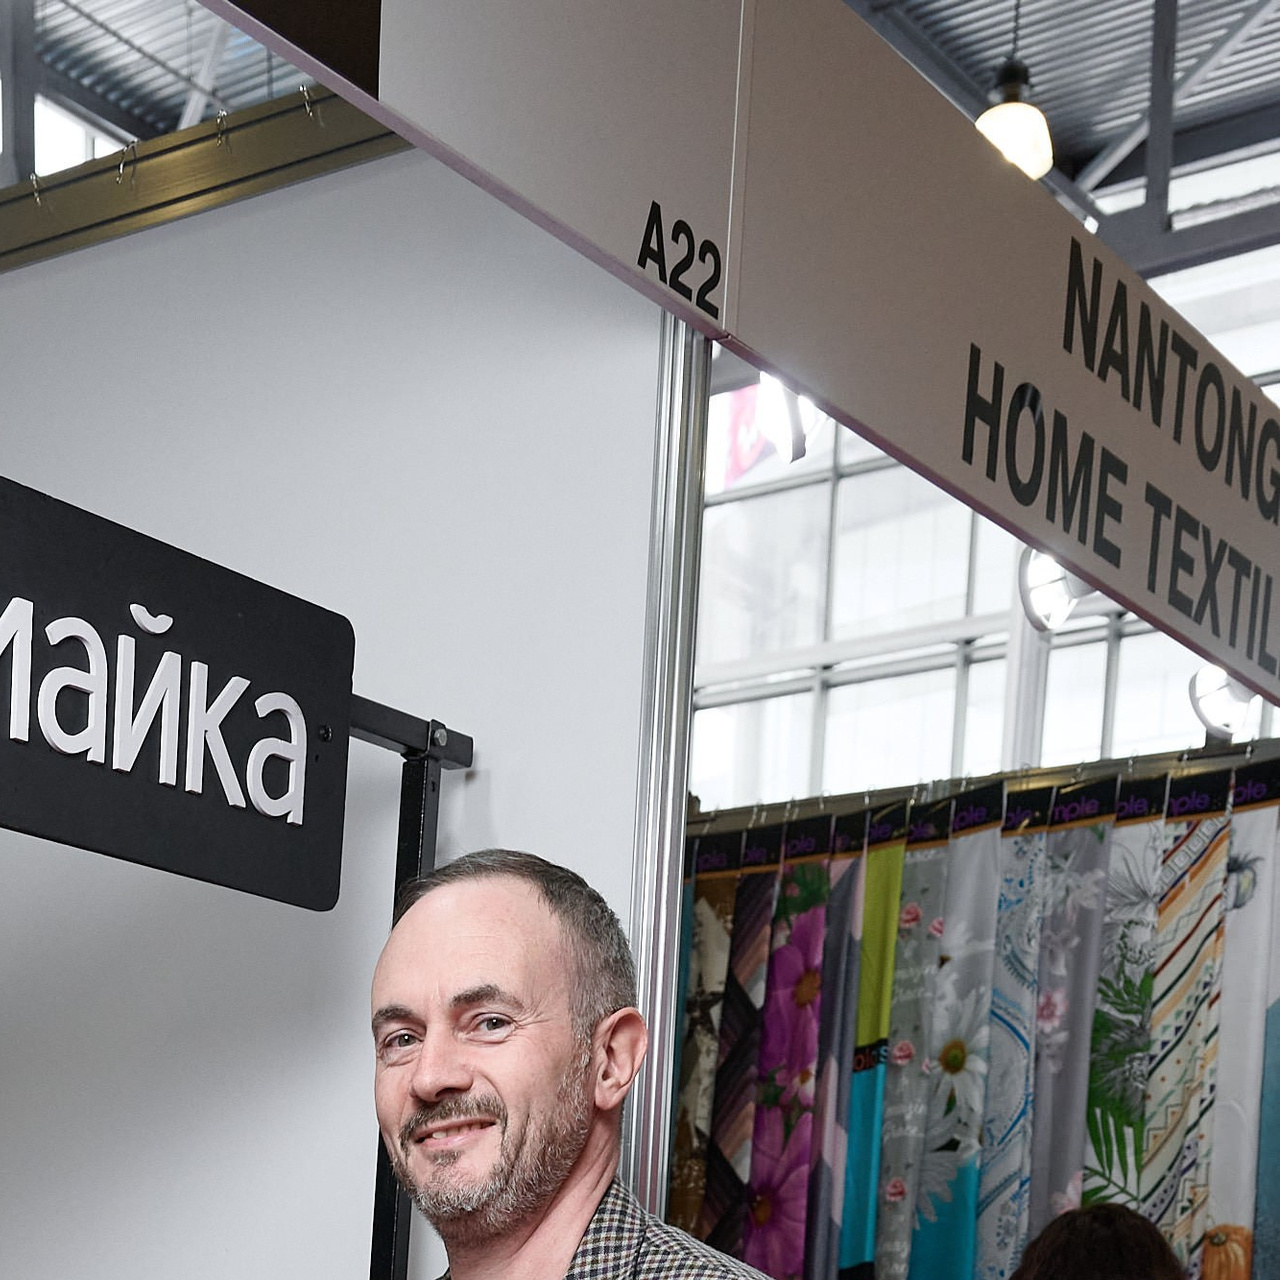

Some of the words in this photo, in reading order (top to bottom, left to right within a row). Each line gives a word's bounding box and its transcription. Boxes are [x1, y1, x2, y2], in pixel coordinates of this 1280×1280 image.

[637, 200, 721, 320] A22
[1062, 236, 1280, 526] NANTONG
[961, 342, 1128, 570] HOME
[1144, 482, 1280, 682] TEXTIL
